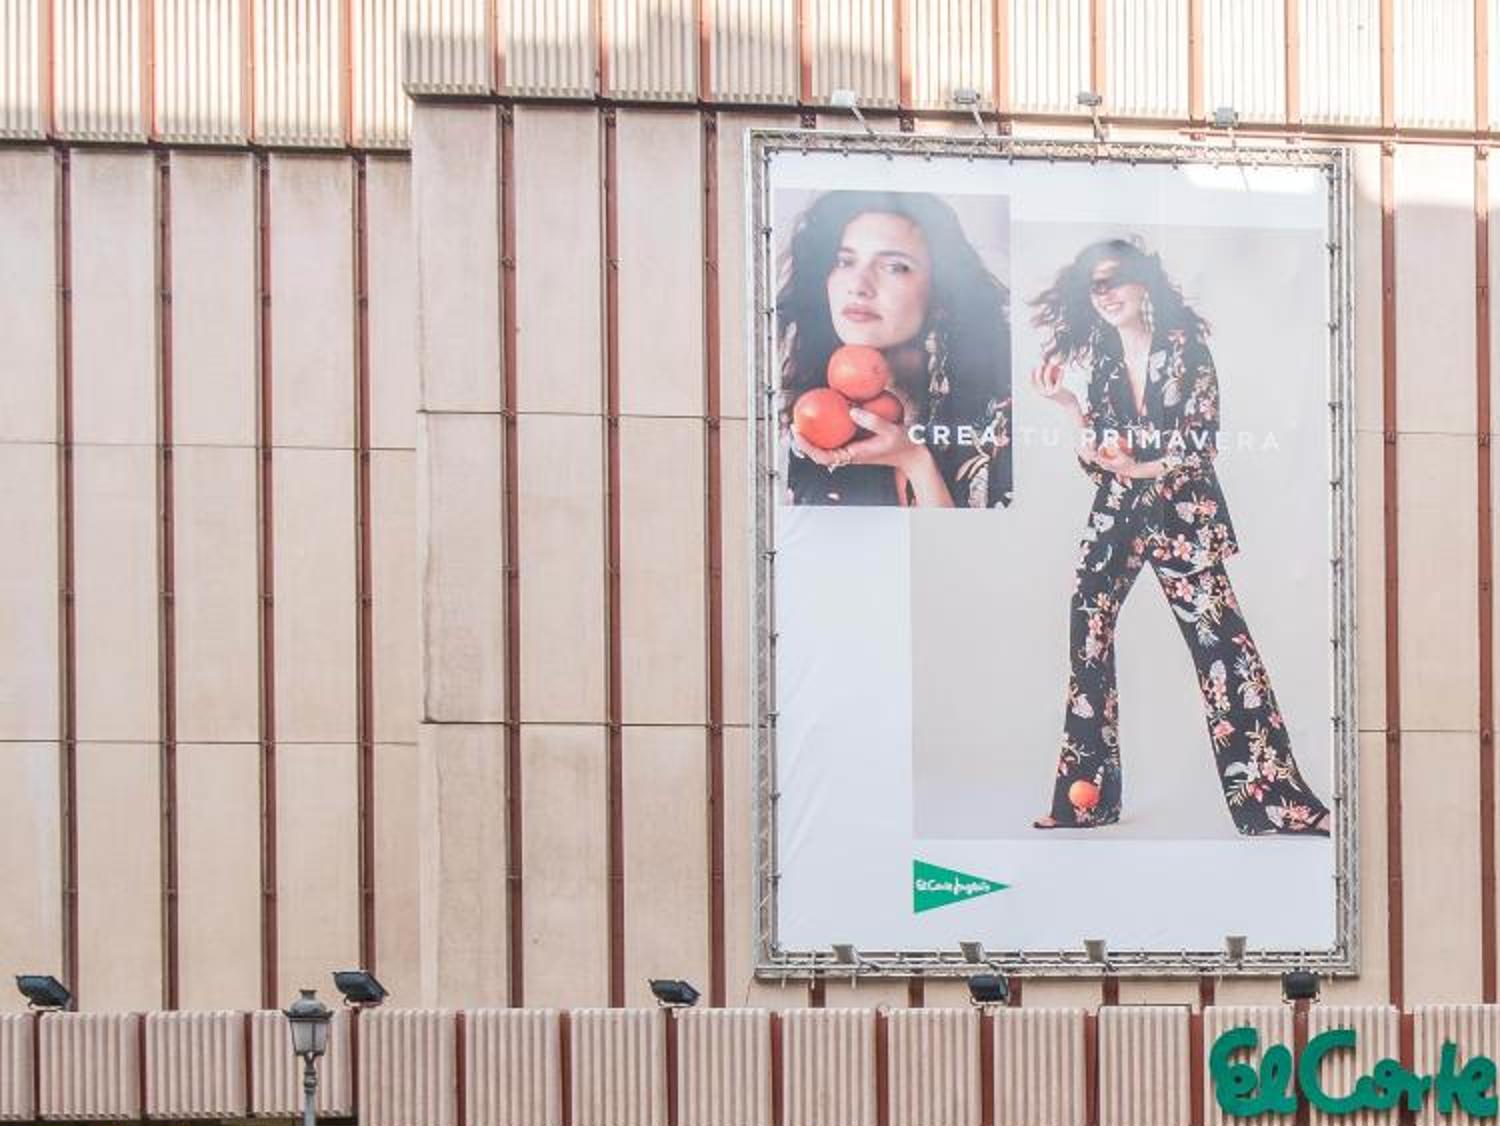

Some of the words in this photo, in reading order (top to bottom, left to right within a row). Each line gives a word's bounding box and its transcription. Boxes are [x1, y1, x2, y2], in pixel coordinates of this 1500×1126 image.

[907, 425, 999, 446] CREA
[1021, 429, 1060, 447] TU
[1079, 427, 1281, 452] PRIMAVERA
[1209, 1026, 1299, 1117] El
[1300, 1027, 1500, 1117] Corte
